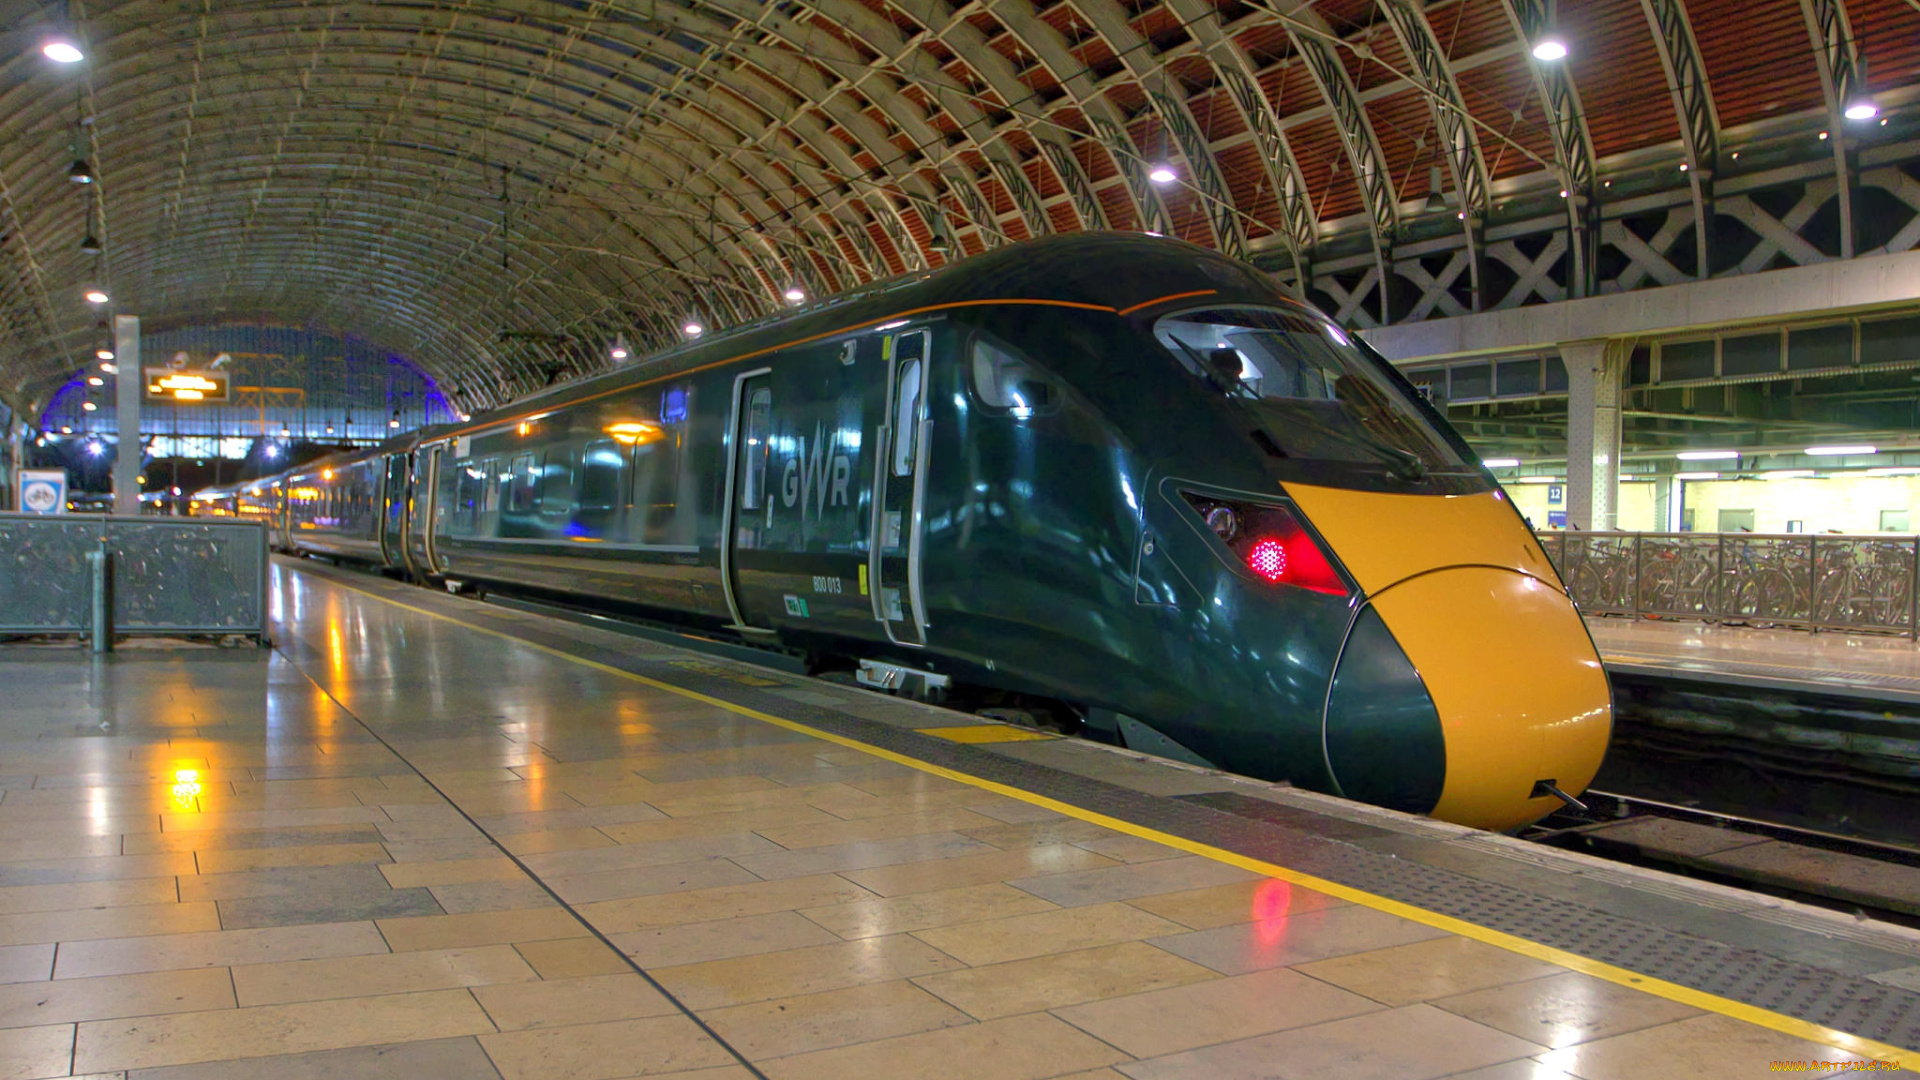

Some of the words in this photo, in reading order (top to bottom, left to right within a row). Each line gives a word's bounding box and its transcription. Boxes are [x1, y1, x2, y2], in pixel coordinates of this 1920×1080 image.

[782, 418, 850, 522] GWR
[1550, 489, 1560, 499] 12
[813, 576, 827, 593] 800
[827, 576, 842, 594] 013
